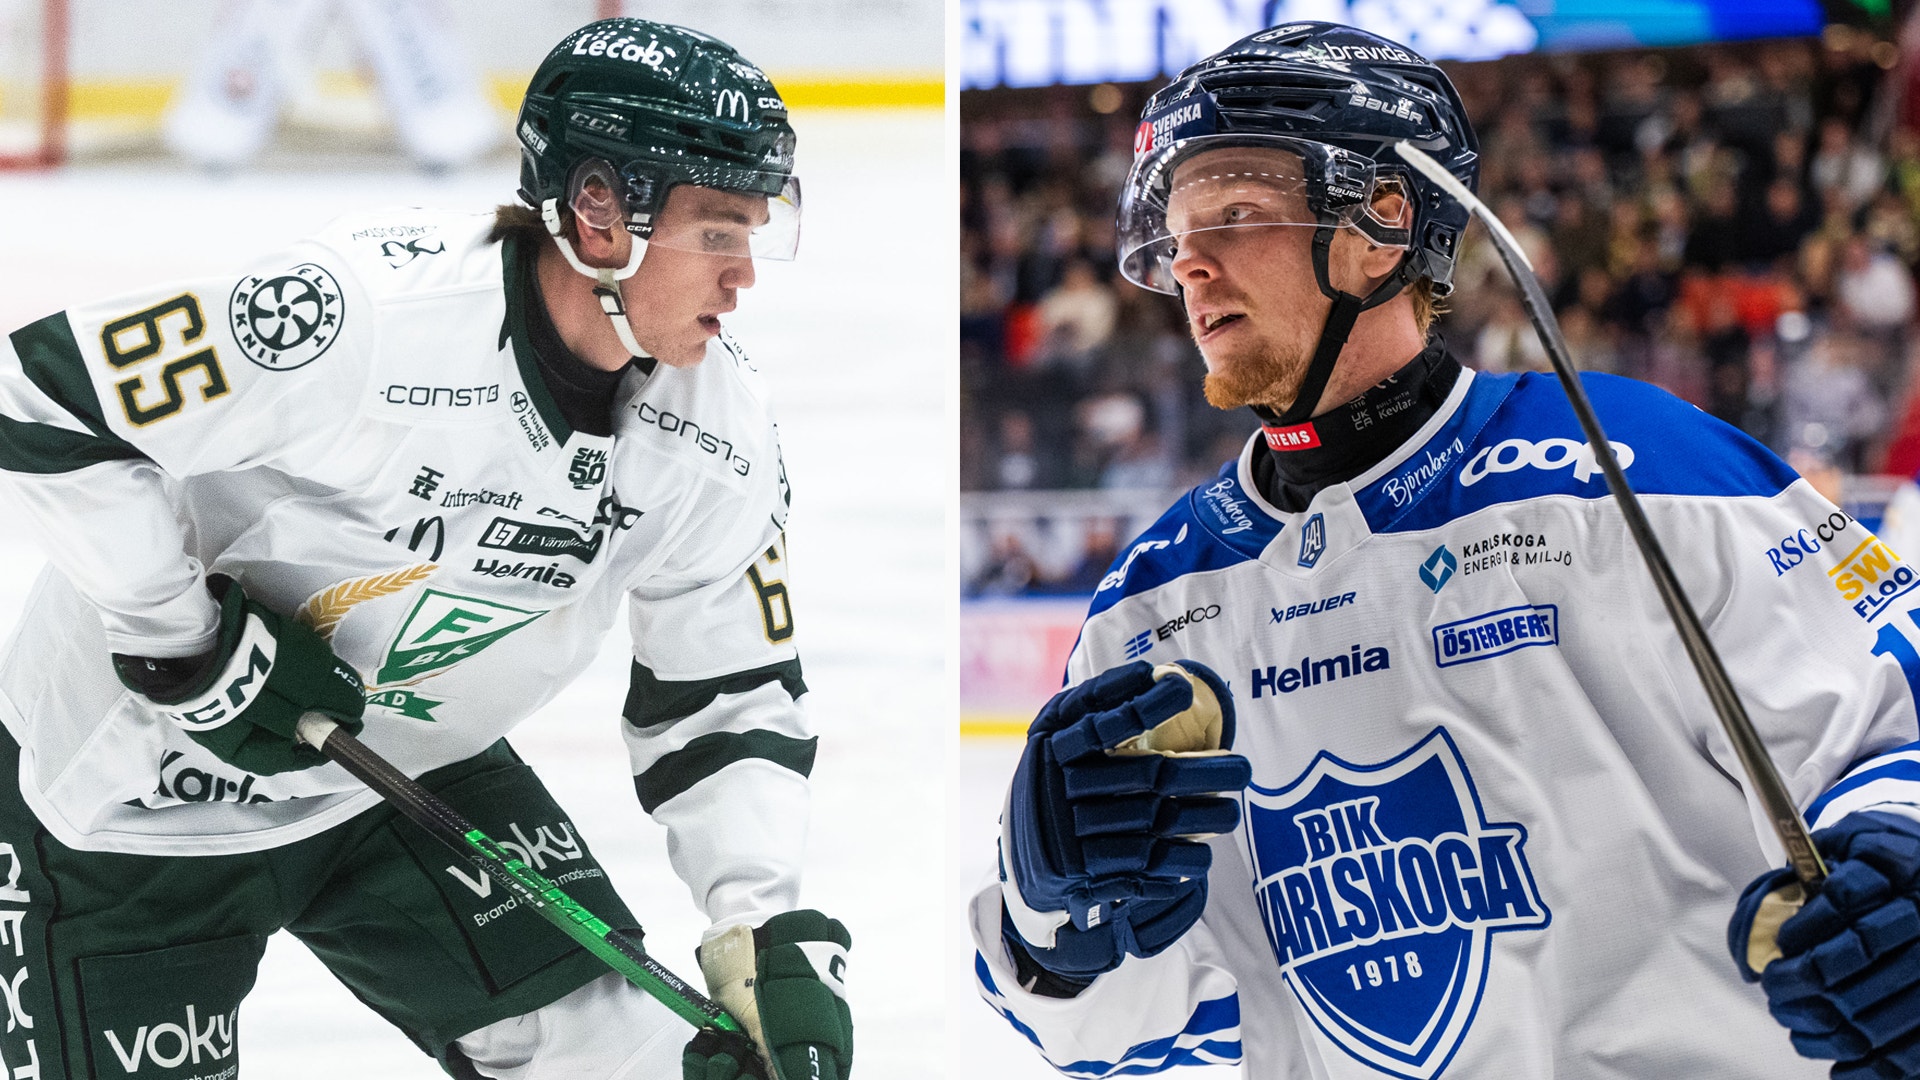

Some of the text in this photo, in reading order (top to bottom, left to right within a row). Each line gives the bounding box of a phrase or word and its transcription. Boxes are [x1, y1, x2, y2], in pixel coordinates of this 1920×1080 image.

[1323, 42, 1412, 63] bravida
[570, 112, 627, 138] CCM
[1152, 102, 1202, 138] SVENSKA
[1349, 95, 1423, 125] BAUER
[1327, 185, 1364, 199] BAUER
[626, 224, 652, 232] CCM
[236, 277, 281, 364] TEKNIK
[298, 267, 338, 347] FLÄKT
[100, 292, 231, 428] 65
[1378, 399, 1412, 420] Kevlar
[1265, 430, 1311, 447] STEMS
[574, 447, 608, 463] SHL
[1459, 438, 1635, 486] coop
[568, 459, 606, 486] 50
[440, 488, 523, 511] Infrakraft
[1463, 534, 1546, 558] KARLSKOGA
[472, 559, 577, 589] Helmia
[1464, 551, 1573, 576] ENERGI & MILJÖ
[1853, 564, 1919, 619] FLOO
[1286, 592, 1357, 623] BAUER
[169, 643, 272, 725] CM
[1251, 644, 1390, 699] Helmia
[1299, 802, 1386, 858] BIK
[473, 896, 518, 927] Brand
[645, 960, 684, 991] FRANSEN
[745, 977, 754, 987] 65
[1346, 951, 1423, 990] 1978
[103, 1004, 237, 1073] voky
[808, 1046, 820, 1080] CC
